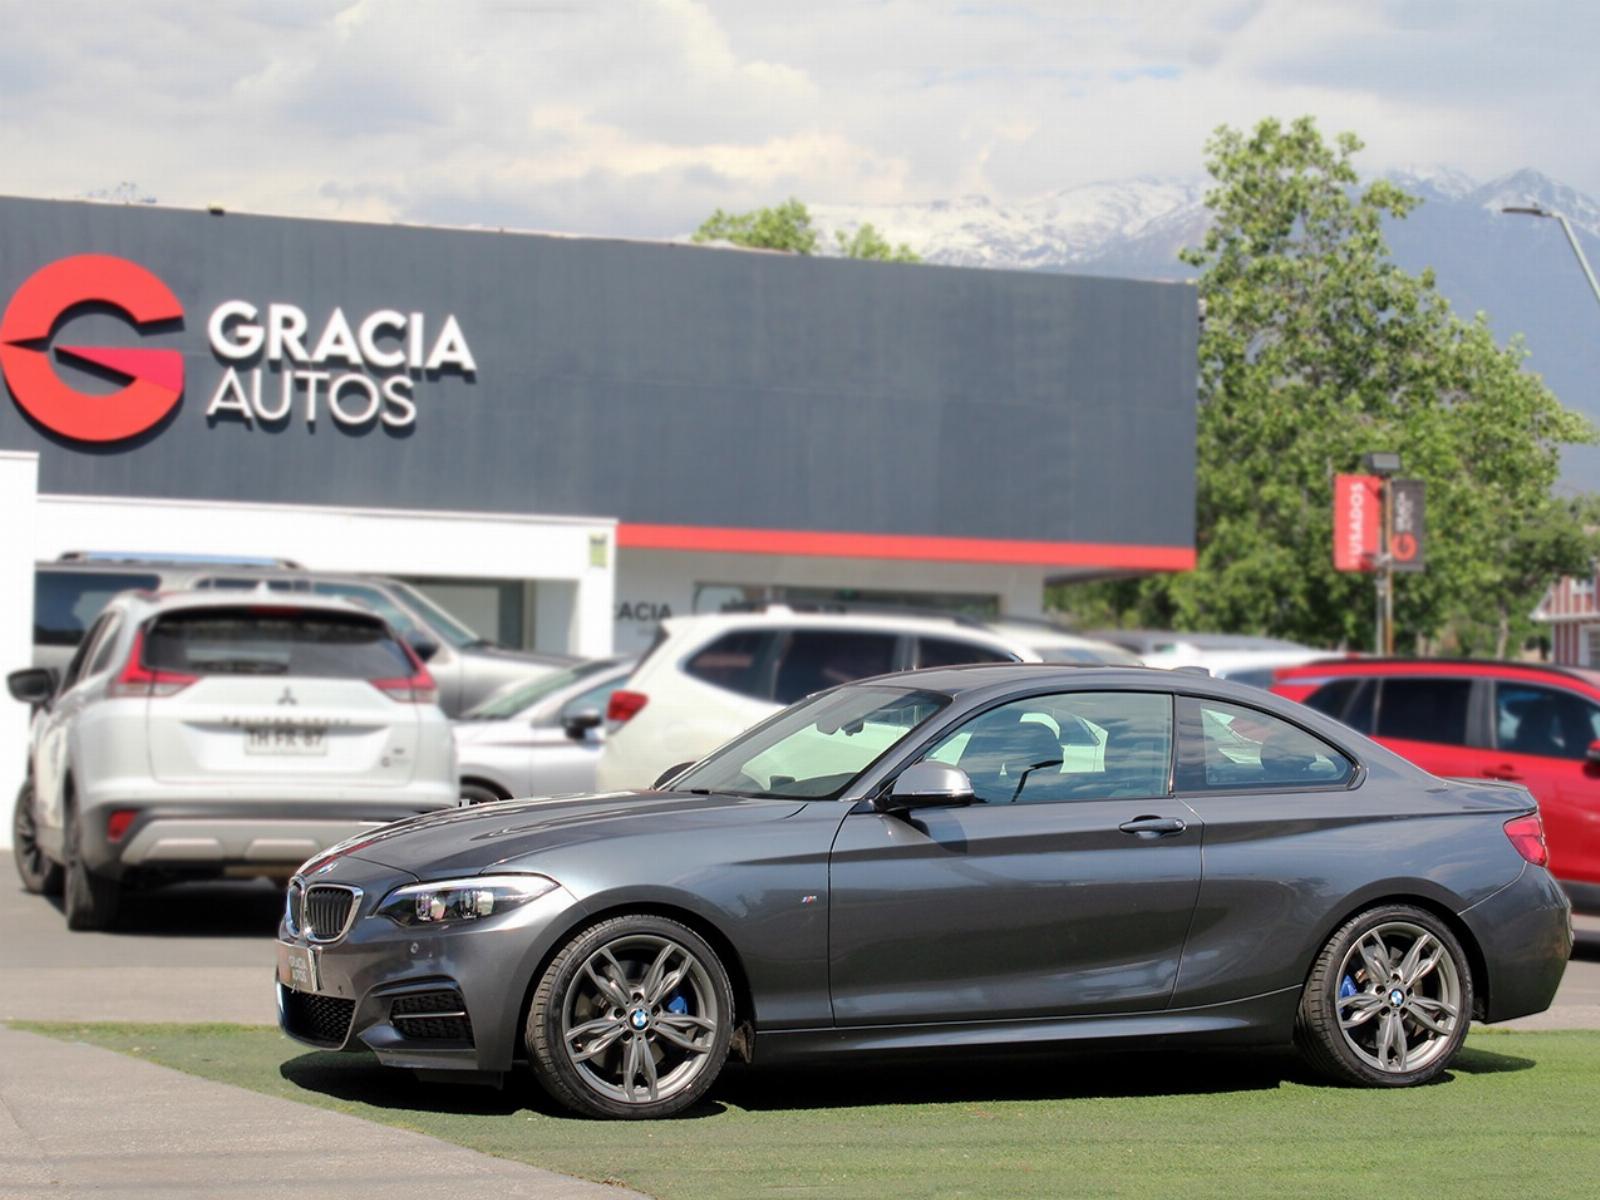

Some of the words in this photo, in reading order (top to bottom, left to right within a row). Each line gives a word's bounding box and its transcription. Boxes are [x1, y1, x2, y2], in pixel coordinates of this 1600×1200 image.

[207, 299, 477, 372] GRACIA
[205, 365, 418, 427] AUTOS
[1348, 482, 1365, 555] USADOS
[615, 601, 672, 621] ACIA
